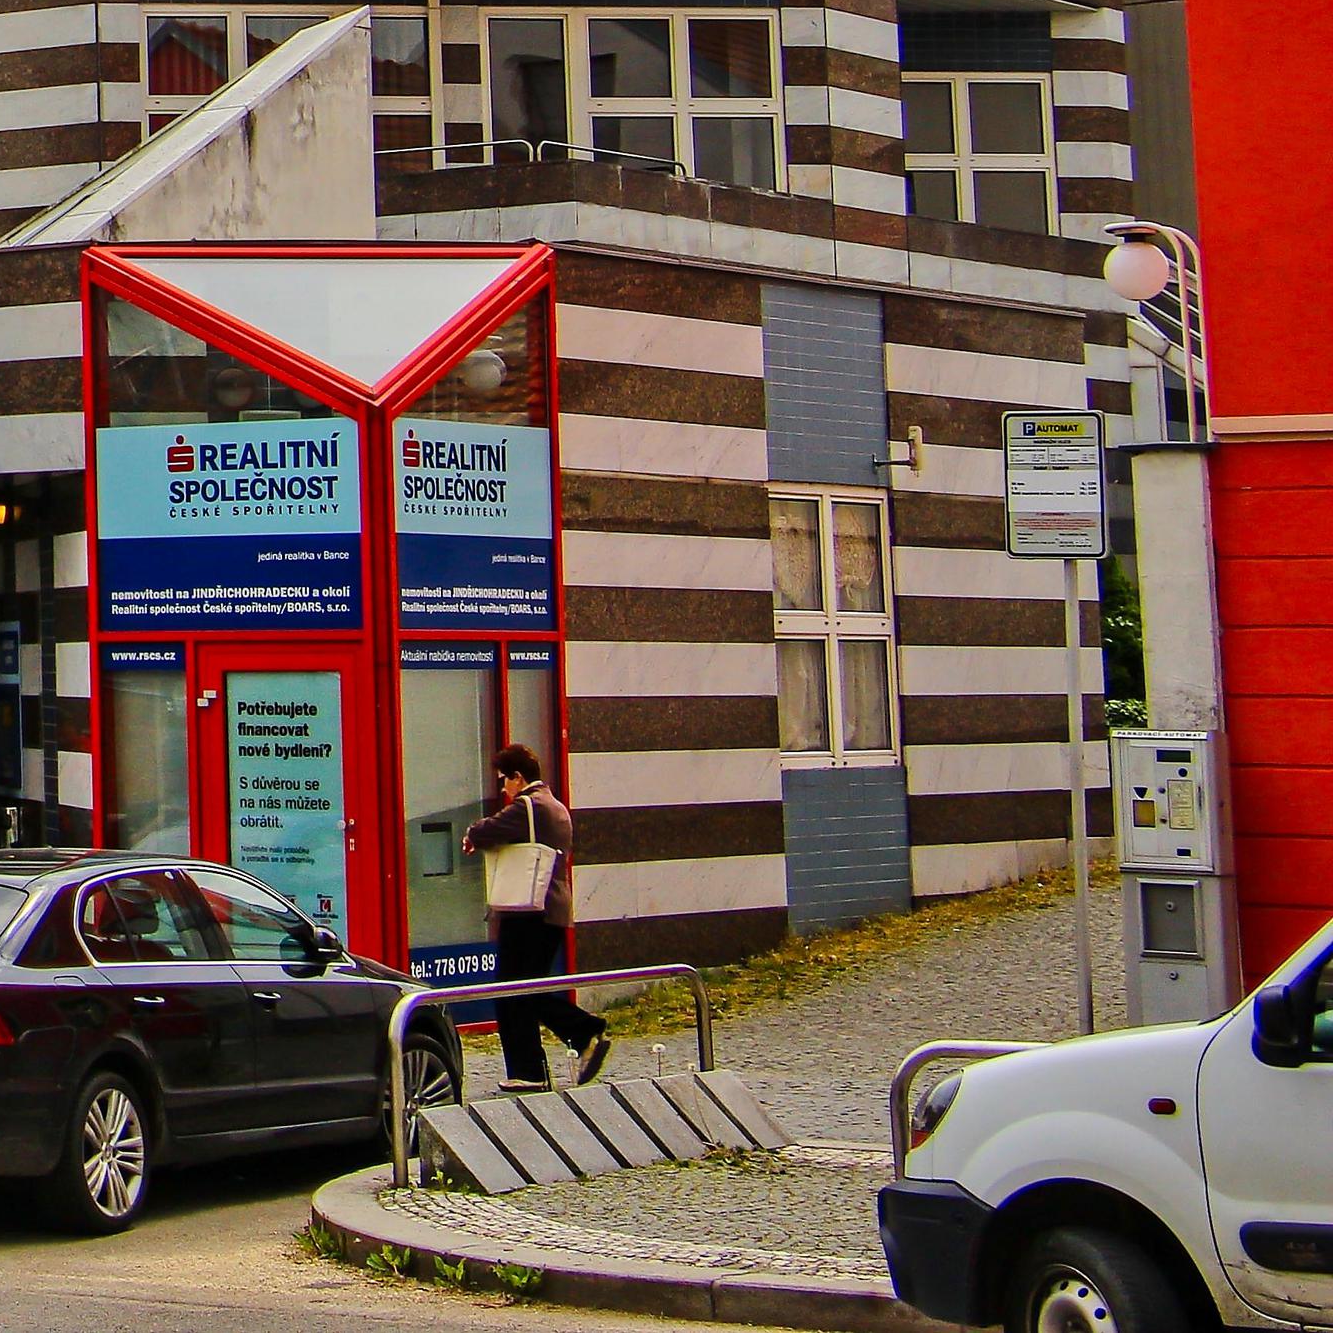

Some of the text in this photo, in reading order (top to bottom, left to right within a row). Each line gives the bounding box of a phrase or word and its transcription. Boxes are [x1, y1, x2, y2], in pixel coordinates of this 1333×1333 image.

[1025, 423, 1079, 434] P AUTOMAT
[199, 432, 341, 472] REALITNÍ
[422, 438, 508, 472] REALITNÍ
[169, 471, 339, 504] SPOLEČNOST
[403, 473, 507, 503] SPOLEČNOST
[169, 503, 340, 518] ČESKÉ SPOŘITELNY
[257, 551, 283, 563] jediná
[285, 551, 315, 560] realitka
[324, 551, 349, 560] Bance
[111, 585, 350, 600] nemovitosti na JINDŘICHOHRADECKU a okolí
[111, 600, 350, 616] Realitní společnost České spořitelny/BOARS, s.r.o.
[111, 651, 176, 661] www.rscs.cz
[237, 700, 318, 719] Potřebujete
[237, 722, 310, 737] financovat
[238, 743, 332, 760] nové bydlení?
[239, 776, 320, 791] S důvěrou se
[239, 796, 331, 810] na nás můžete
[240, 814, 284, 828] obrátit.
[410, 953, 498, 979] tel.: 778 079 89
